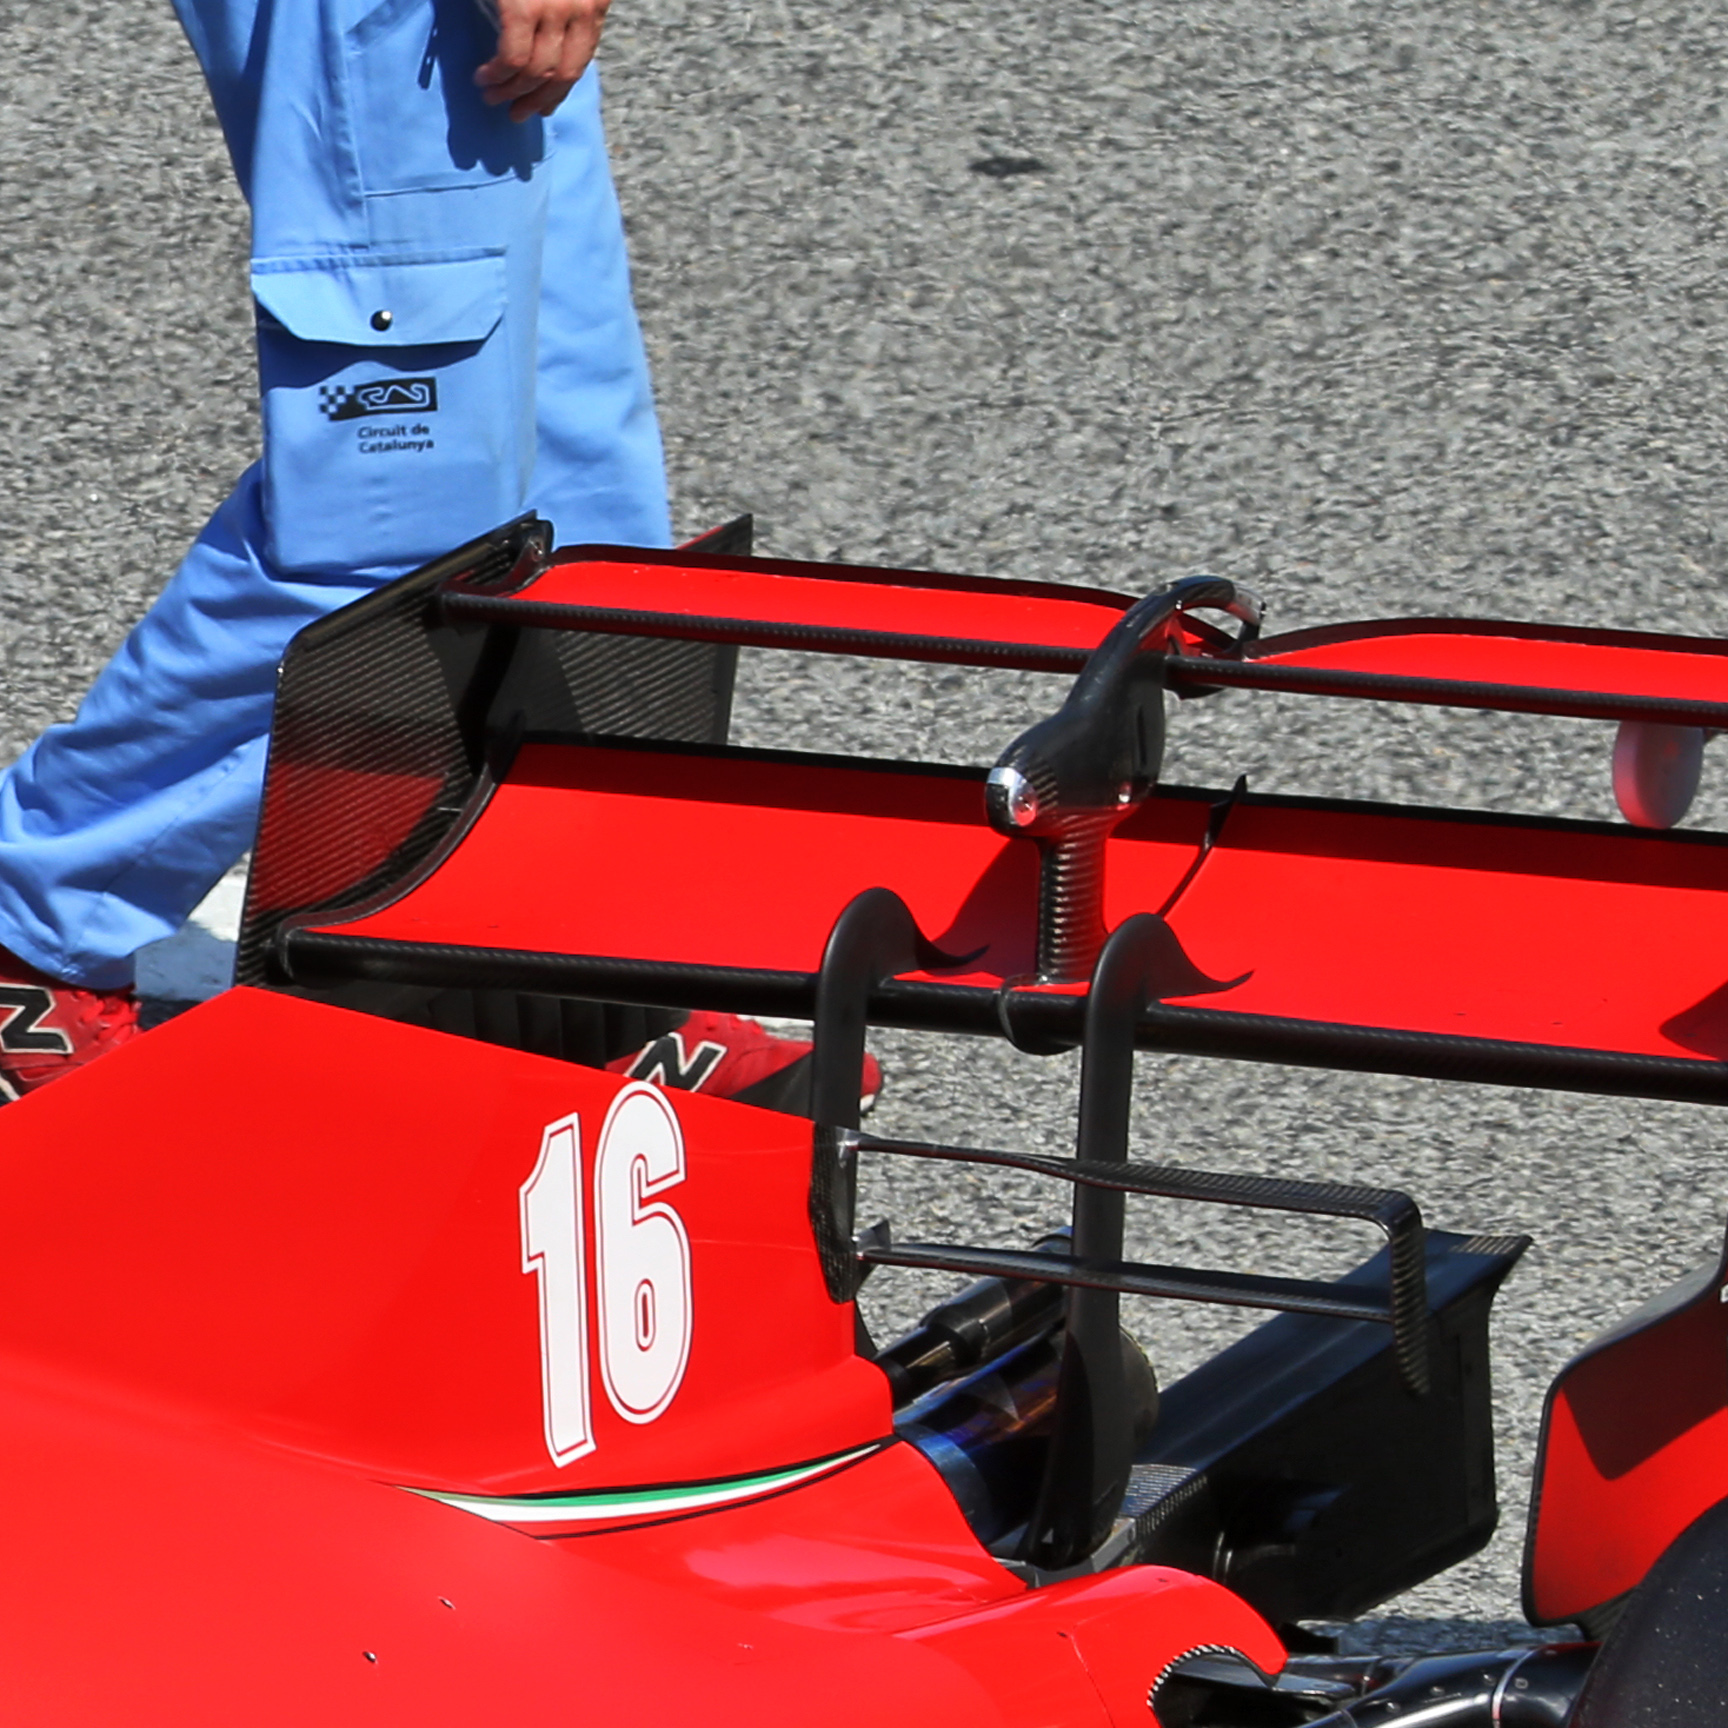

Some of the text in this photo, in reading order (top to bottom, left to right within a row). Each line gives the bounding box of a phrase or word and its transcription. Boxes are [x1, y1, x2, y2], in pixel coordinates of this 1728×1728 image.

[357, 423, 430, 439] Circuit de
[358, 439, 435, 454] Catalunya
[519, 1079, 694, 1468] 16
